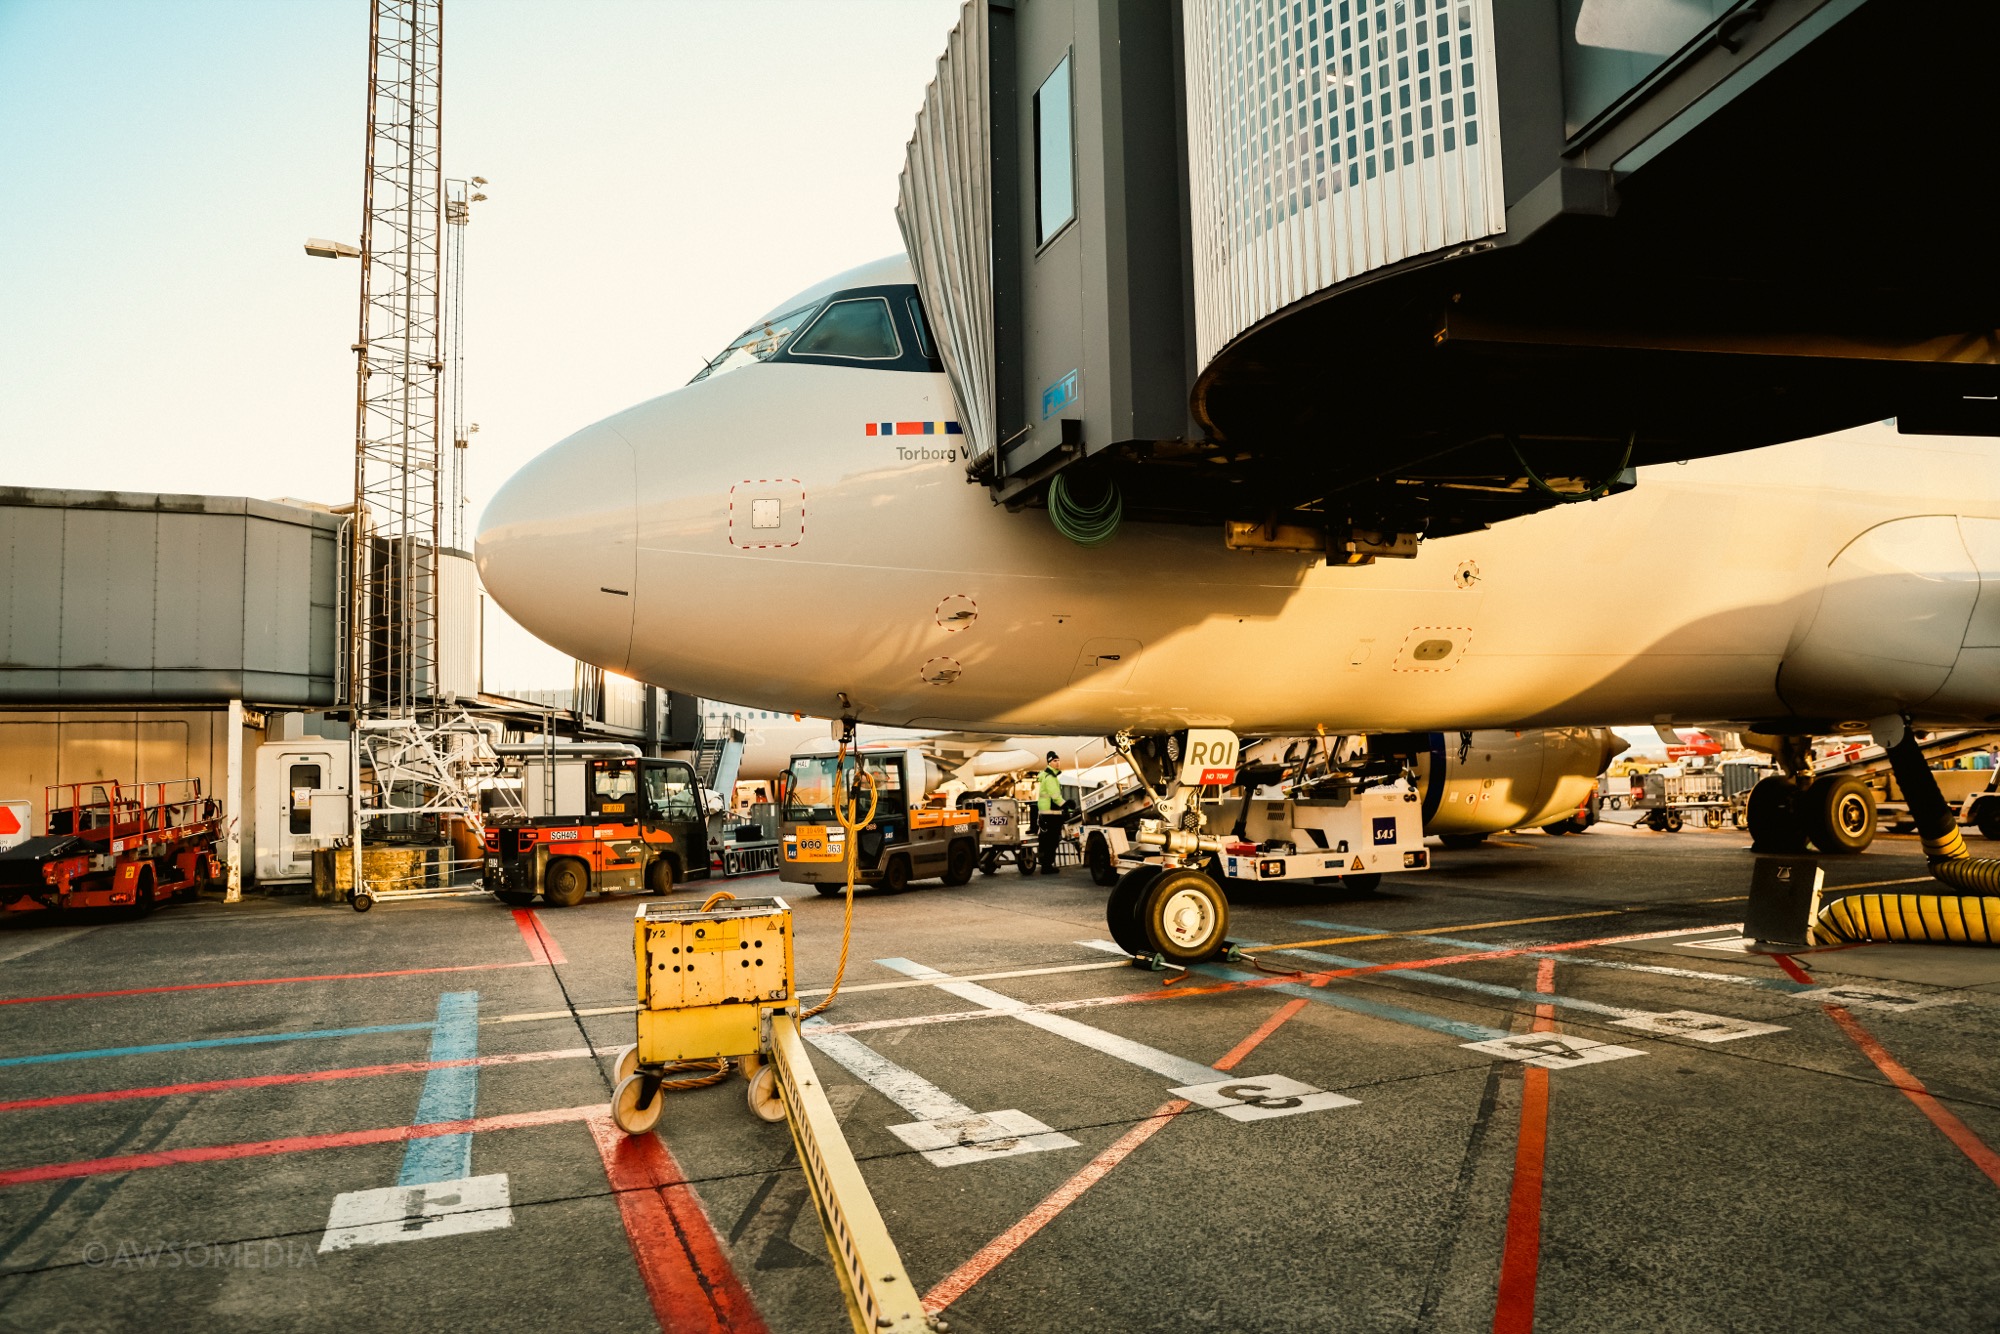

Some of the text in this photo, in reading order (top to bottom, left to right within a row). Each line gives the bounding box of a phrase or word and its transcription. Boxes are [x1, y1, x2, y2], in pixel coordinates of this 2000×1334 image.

[1044, 375, 1076, 414] FMT
[896, 446, 956, 462] Torborg
[990, 816, 1008, 826] 2957
[551, 831, 577, 840] SGH405
[1374, 829, 1395, 840] SAS
[828, 844, 841, 853] 363
[1218, 1084, 1303, 1109] 3
